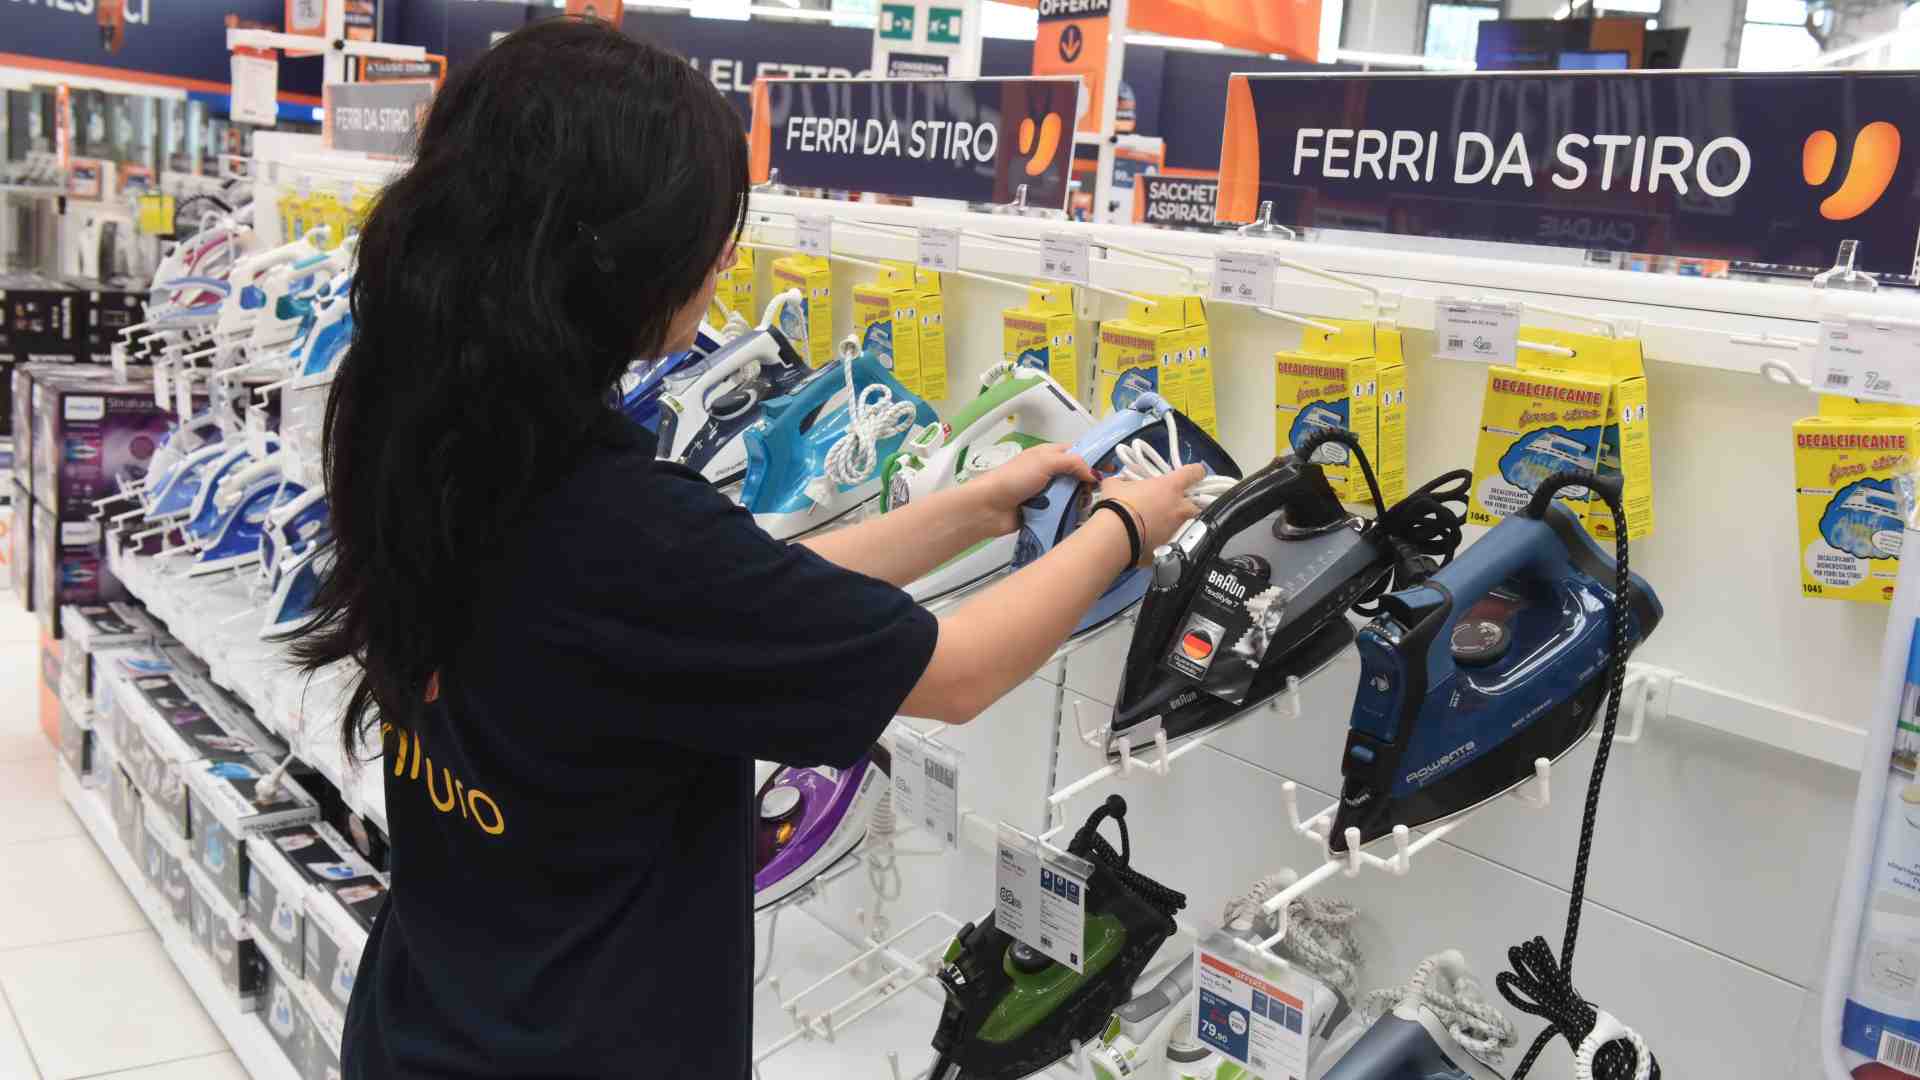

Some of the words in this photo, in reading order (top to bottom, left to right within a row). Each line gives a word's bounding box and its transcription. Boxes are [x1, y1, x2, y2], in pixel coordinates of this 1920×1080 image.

[335, 107, 362, 131] FERRI
[364, 108, 378, 131] DA
[380, 109, 409, 133] STIRO
[786, 116, 858, 154] FERRI
[863, 119, 901, 157] DA
[908, 120, 998, 162] STIRO
[1292, 128, 1438, 182] FERRI
[1453, 131, 1533, 188] DA
[1551, 133, 1751, 197] STIRO
[1494, 378, 1601, 407] DECALCIFICANTE
[1797, 433, 1905, 449] DECALCIFICANTE
[1471, 512, 1489, 522] 1045
[1208, 569, 1247, 599] BRAUN
[1803, 584, 1823, 593] 1045
